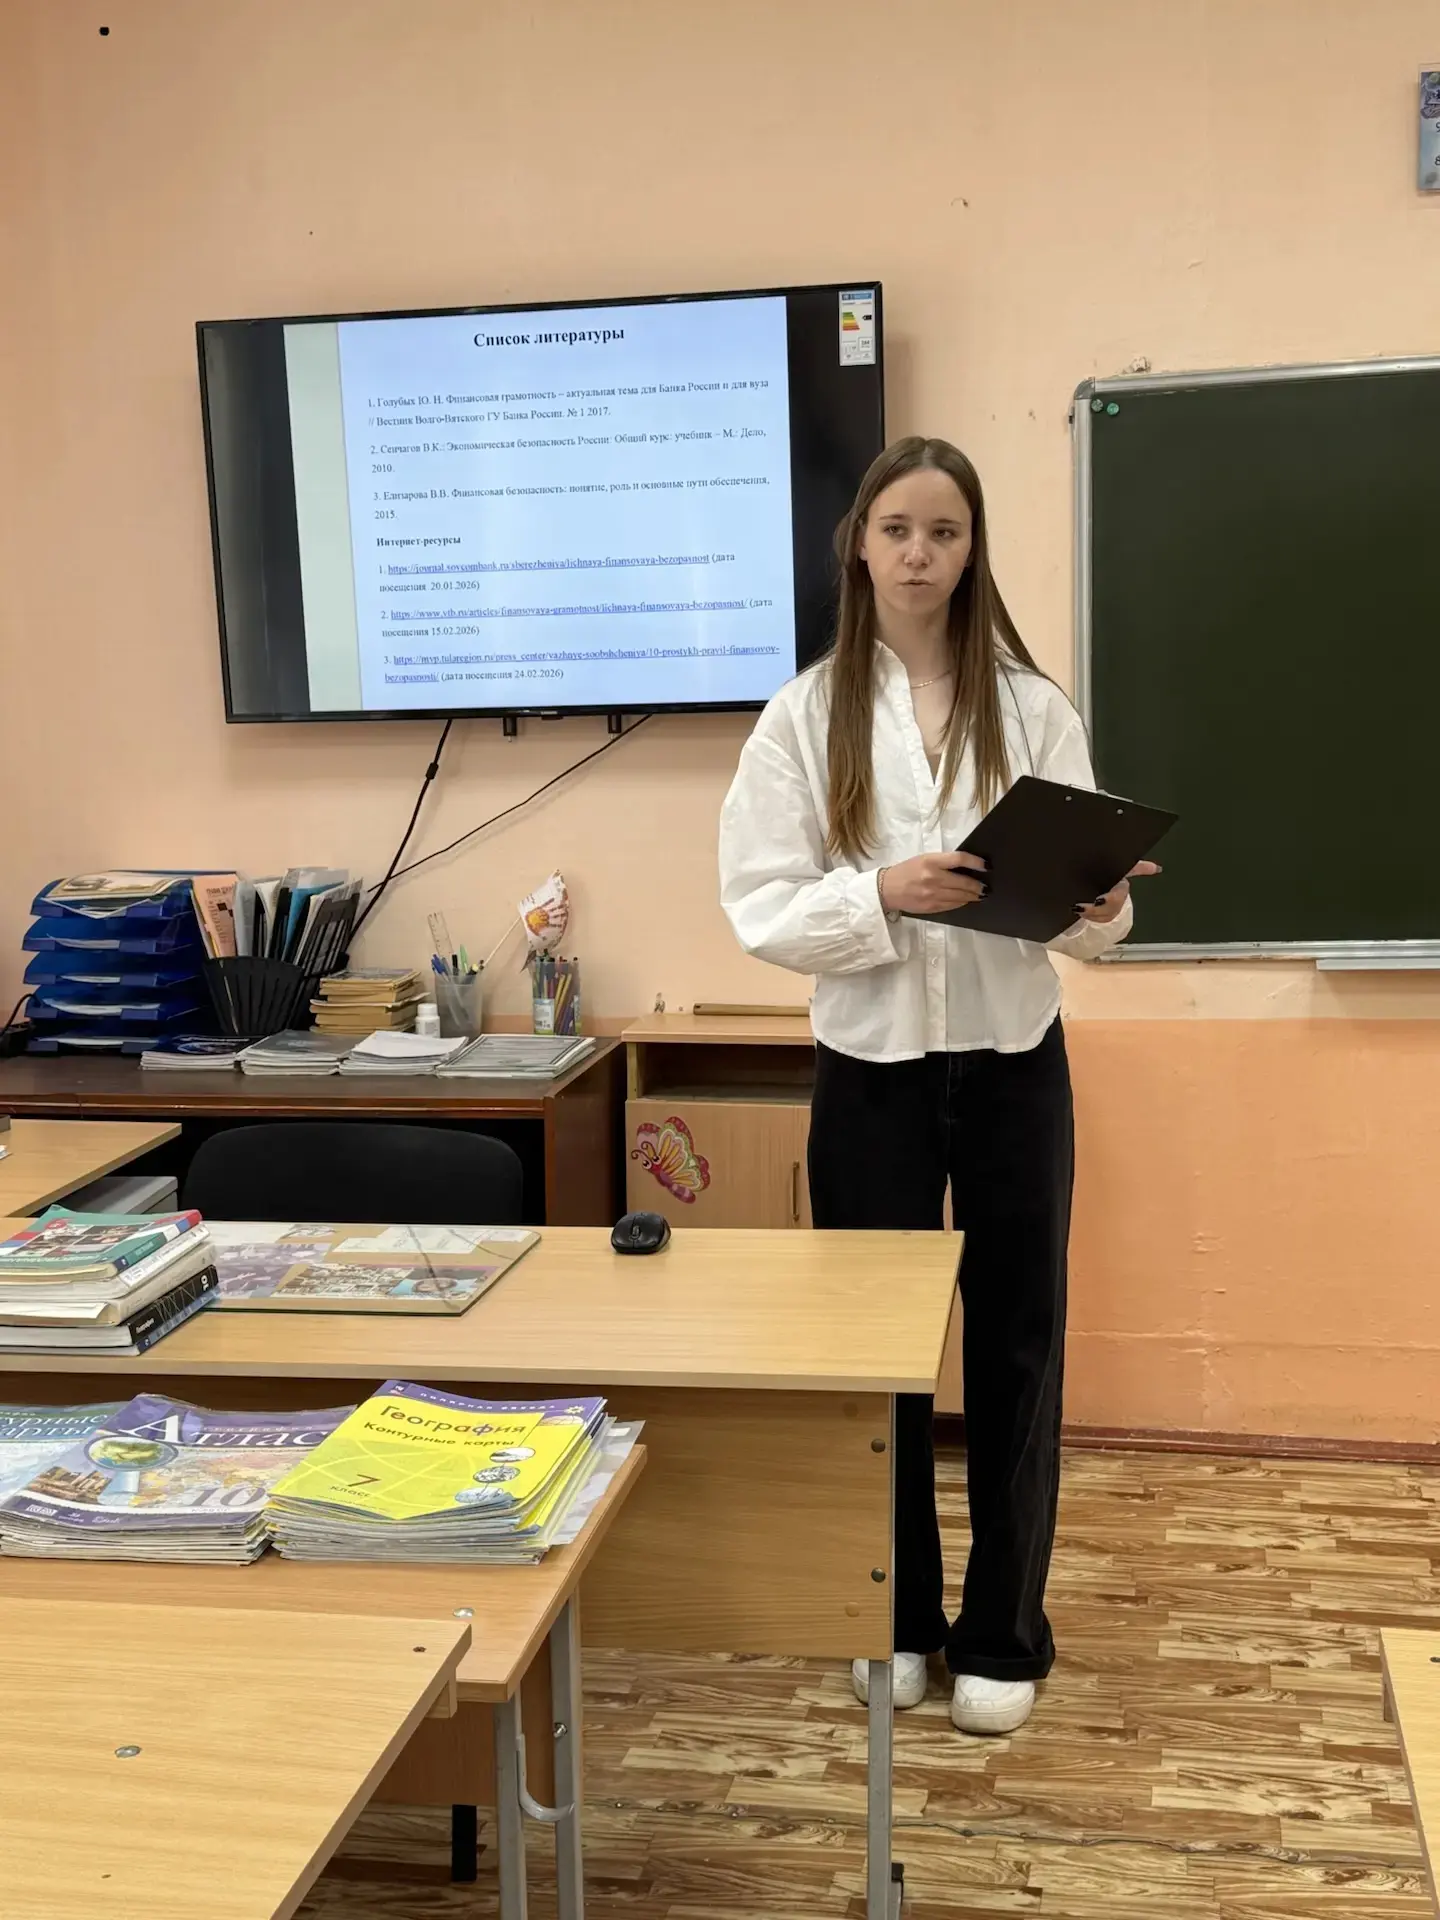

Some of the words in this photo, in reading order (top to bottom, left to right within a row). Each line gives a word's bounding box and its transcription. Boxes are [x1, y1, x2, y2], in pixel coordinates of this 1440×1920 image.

[473, 333, 530, 347] Список
[534, 328, 624, 345] литературы
[368, 399, 375, 407] 1.
[377, 397, 415, 408] Голубых
[418, 395, 431, 405] Ю.
[433, 395, 444, 404] Н.
[446, 394, 499, 403] Финансовая
[501, 391, 556, 403] грамотность
[566, 388, 615, 399] актуальная
[618, 387, 638, 396] тема
[641, 386, 656, 395] для
[659, 384, 686, 393] Банка
[688, 382, 720, 392] России
[723, 382, 729, 390] и
[731, 381, 747, 390] для
[749, 380, 769, 390] вуза
[377, 416, 413, 426] Вестник
[415, 414, 485, 424] Волго-Вятского
[487, 411, 500, 421] ГУ
[503, 411, 529, 420] Банка
[531, 410, 565, 419] России.
[567, 408, 578, 417] №
[580, 407, 585, 417] 1
[587, 406, 611, 416] 2017.
[370, 445, 378, 454] 2.
[380, 444, 420, 454] Сенчагов
[447, 441, 515, 451] Экономическая
[517, 438, 575, 448] безопасность
[614, 433, 647, 443] Общий
[675, 430, 712, 442] учебник
[740, 428, 766, 439] Дело,
[372, 464, 395, 473] 2010.
[373, 492, 381, 501] 3.
[384, 491, 428, 501] Елизарова
[430, 489, 449, 499] В.В.
[452, 488, 504, 498] Финансовая
[506, 486, 567, 496] безопасность:
[569, 484, 608, 493] понятие,
[610, 483, 631, 493] роль
[641, 480, 683, 490] основные
[686, 479, 708, 490] пути
[710, 477, 770, 486] обеспечения,
[374, 510, 397, 520] 2015.
[376, 537, 461, 547] Интернет-ресурсы
[379, 565, 386, 574] 1.
[712, 553, 735, 563] (дата
[380, 583, 426, 593] посещения
[430, 580, 480, 591] 20.01.2026)
[381, 610, 388, 619] 2.
[749, 599, 773, 608] (дата
[382, 628, 429, 637] посещения
[432, 626, 480, 636] 15.02.2026)
[384, 656, 391, 664] 3.
[385, 672, 440, 683] bezopasnosti/
[441, 672, 463, 681] (дата
[465, 671, 512, 681] посещения
[515, 669, 564, 679] 24.02.2026)
[0, 1414, 108, 1428] урные
[380, 1405, 526, 1436] География
[0, 1426, 92, 1440] арты
[117, 1414, 328, 1447] Атлас
[364, 1421, 456, 1445] Контурные
[463, 1440, 514, 1448] карты
[347, 1473, 381, 1487] 7
[187, 1486, 266, 1507] 10
[330, 1485, 370, 1497] класс
